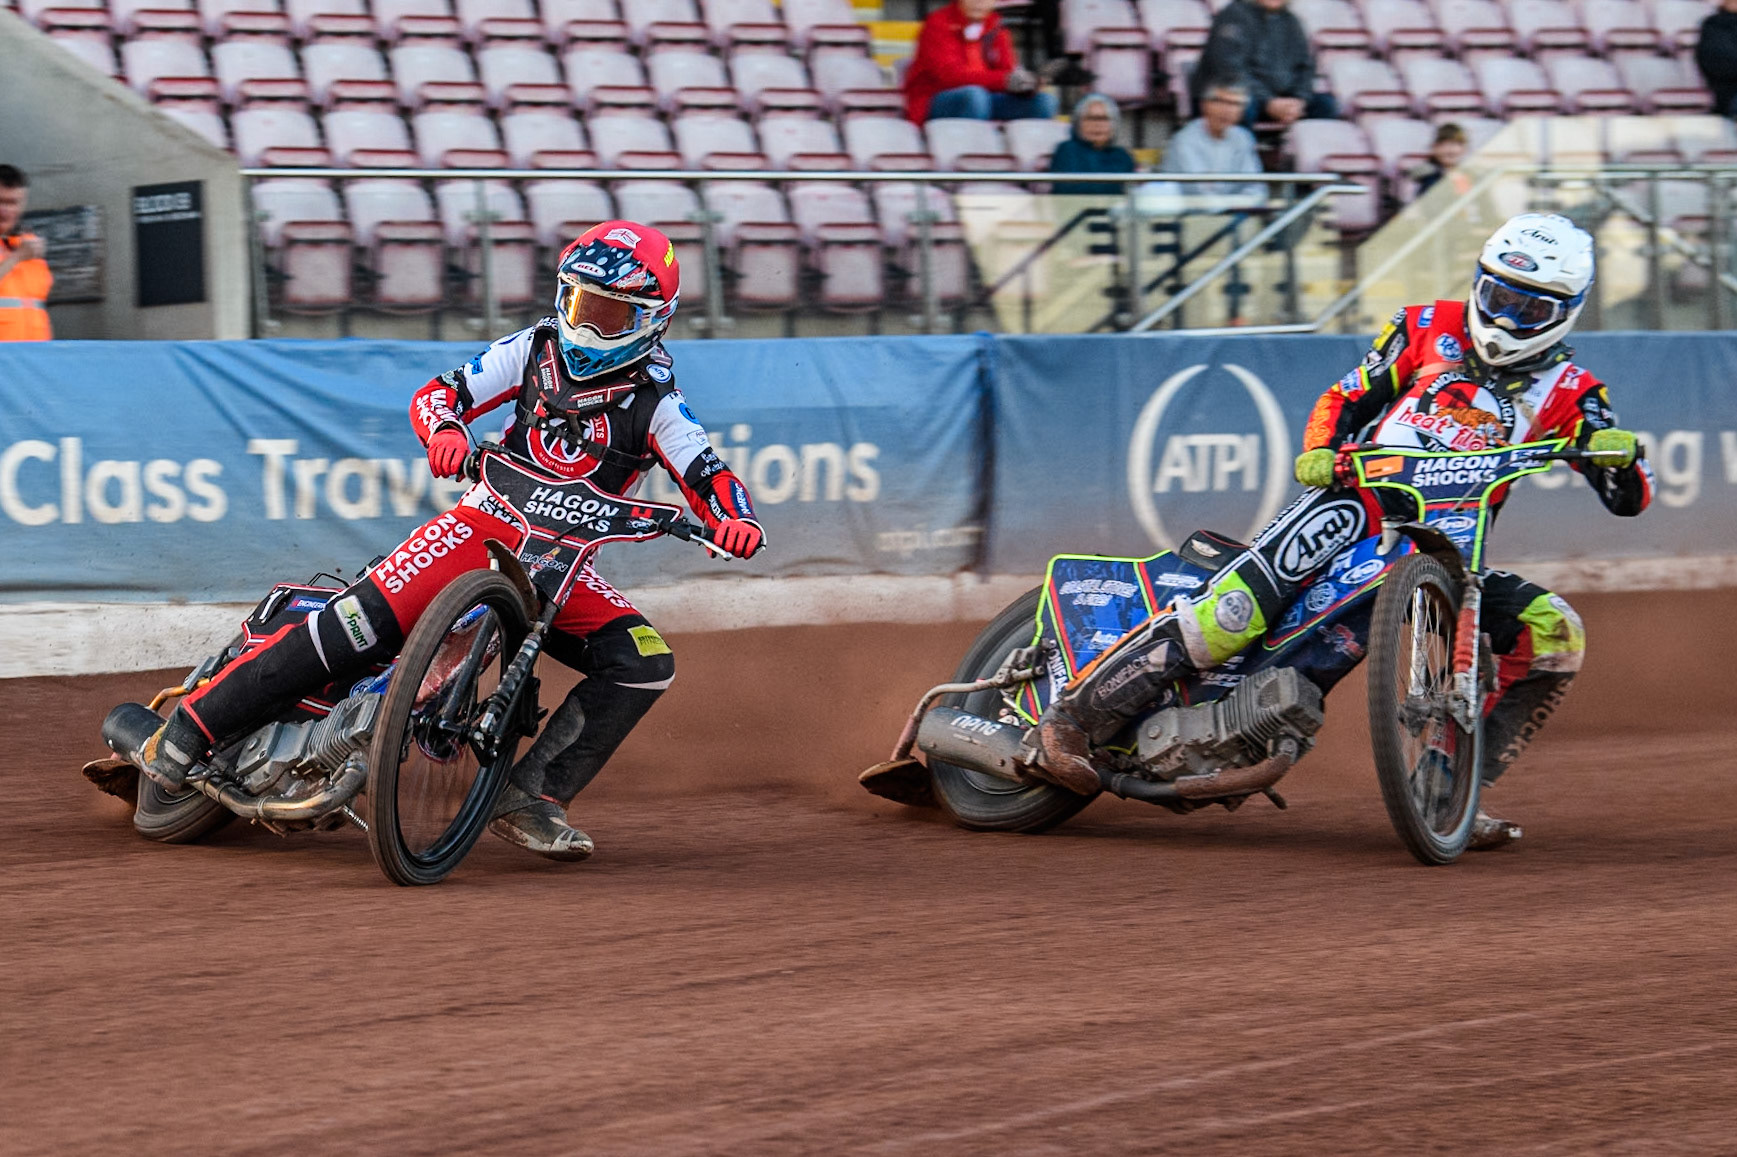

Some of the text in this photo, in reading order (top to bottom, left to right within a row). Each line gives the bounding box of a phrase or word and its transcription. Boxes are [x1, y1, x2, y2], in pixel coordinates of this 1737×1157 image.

[577, 264, 599, 273] BELL
[577, 395, 603, 404] HAGON
[577, 399, 604, 408] SHOCKS
[1398, 405, 1495, 452] heat flo
[1, 437, 228, 527] Class
[246, 431, 500, 521] Trave
[1153, 433, 1260, 493] ATPI
[1412, 470, 1497, 488] SHOCKS
[1415, 456, 1501, 473] HAGON
[523, 501, 612, 533] SHOCKS
[530, 486, 620, 517] HAGON
[376, 513, 457, 582] HAGON
[385, 522, 474, 595] SHOCKS
[520, 552, 569, 573] HAGON
[344, 611, 369, 648] SPRINT
[1097, 655, 1149, 698] BONIFACE
